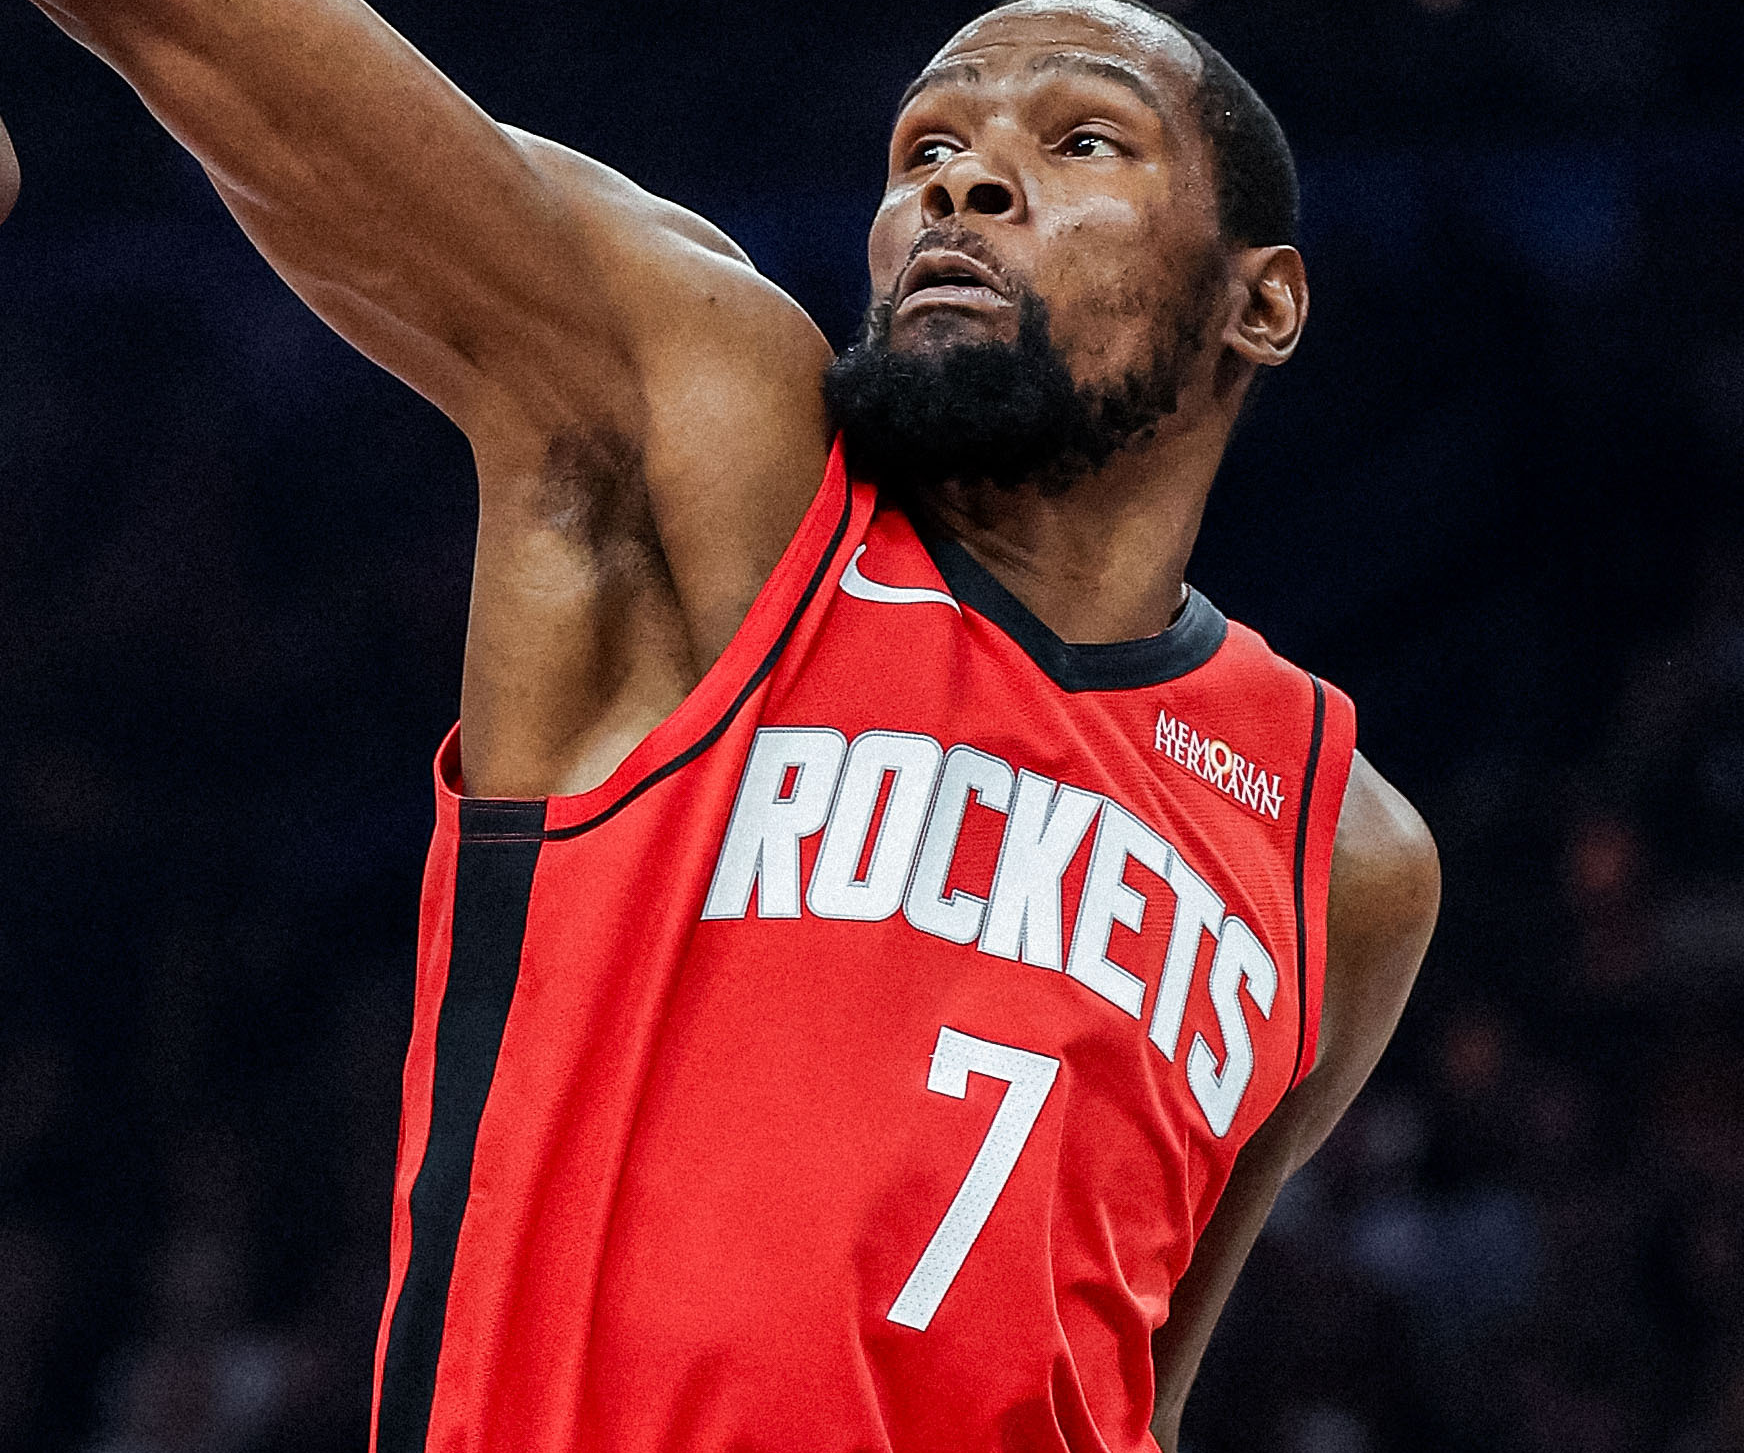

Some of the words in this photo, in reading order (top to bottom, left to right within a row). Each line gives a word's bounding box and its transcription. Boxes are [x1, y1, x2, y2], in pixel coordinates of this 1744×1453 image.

[1154, 727, 1285, 820] HERMANN
[1155, 710, 1282, 799] MEMORIAL
[701, 727, 1278, 1137] ROCKETS
[886, 1026, 1059, 1333] 7
